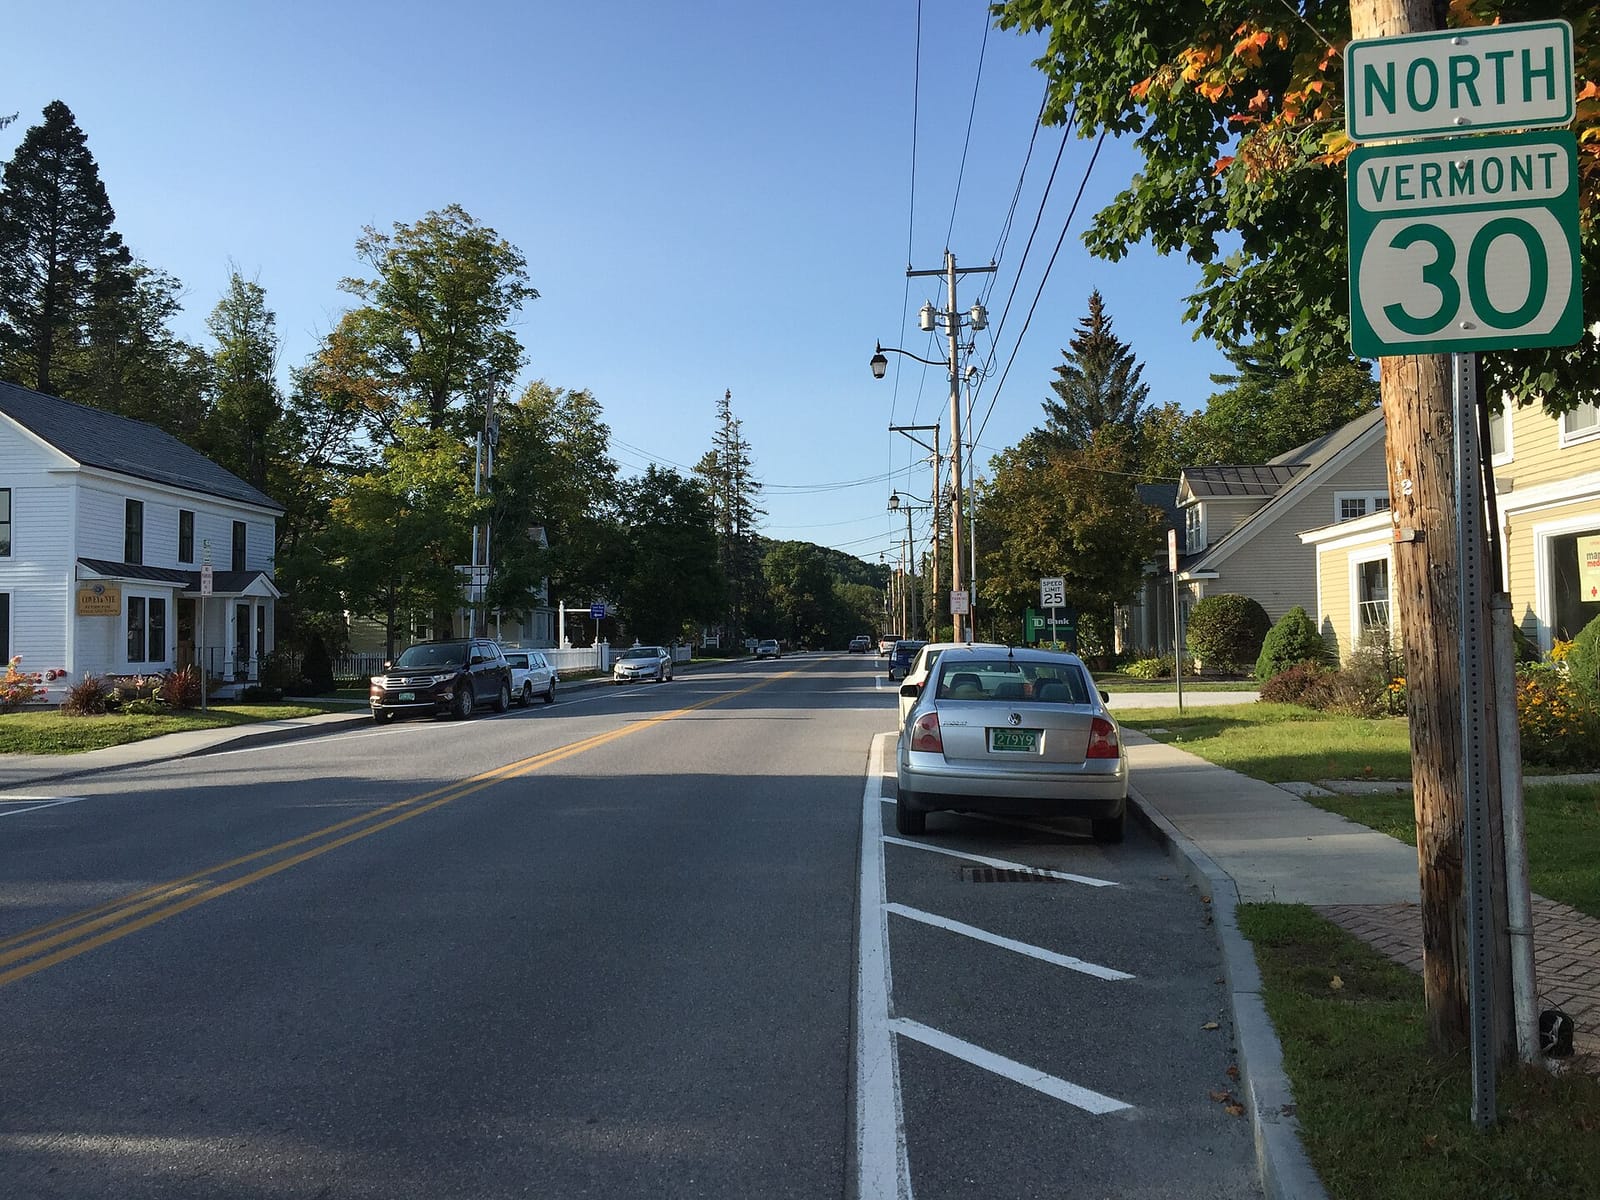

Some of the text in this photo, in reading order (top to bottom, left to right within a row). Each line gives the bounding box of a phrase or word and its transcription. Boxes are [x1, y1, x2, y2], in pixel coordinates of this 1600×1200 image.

[1363, 46, 1556, 118] NORTH
[1367, 152, 1557, 203] VERMONT
[1383, 217, 1549, 336] 30
[1032, 618, 1044, 627] TD
[1044, 593, 1063, 604] 25
